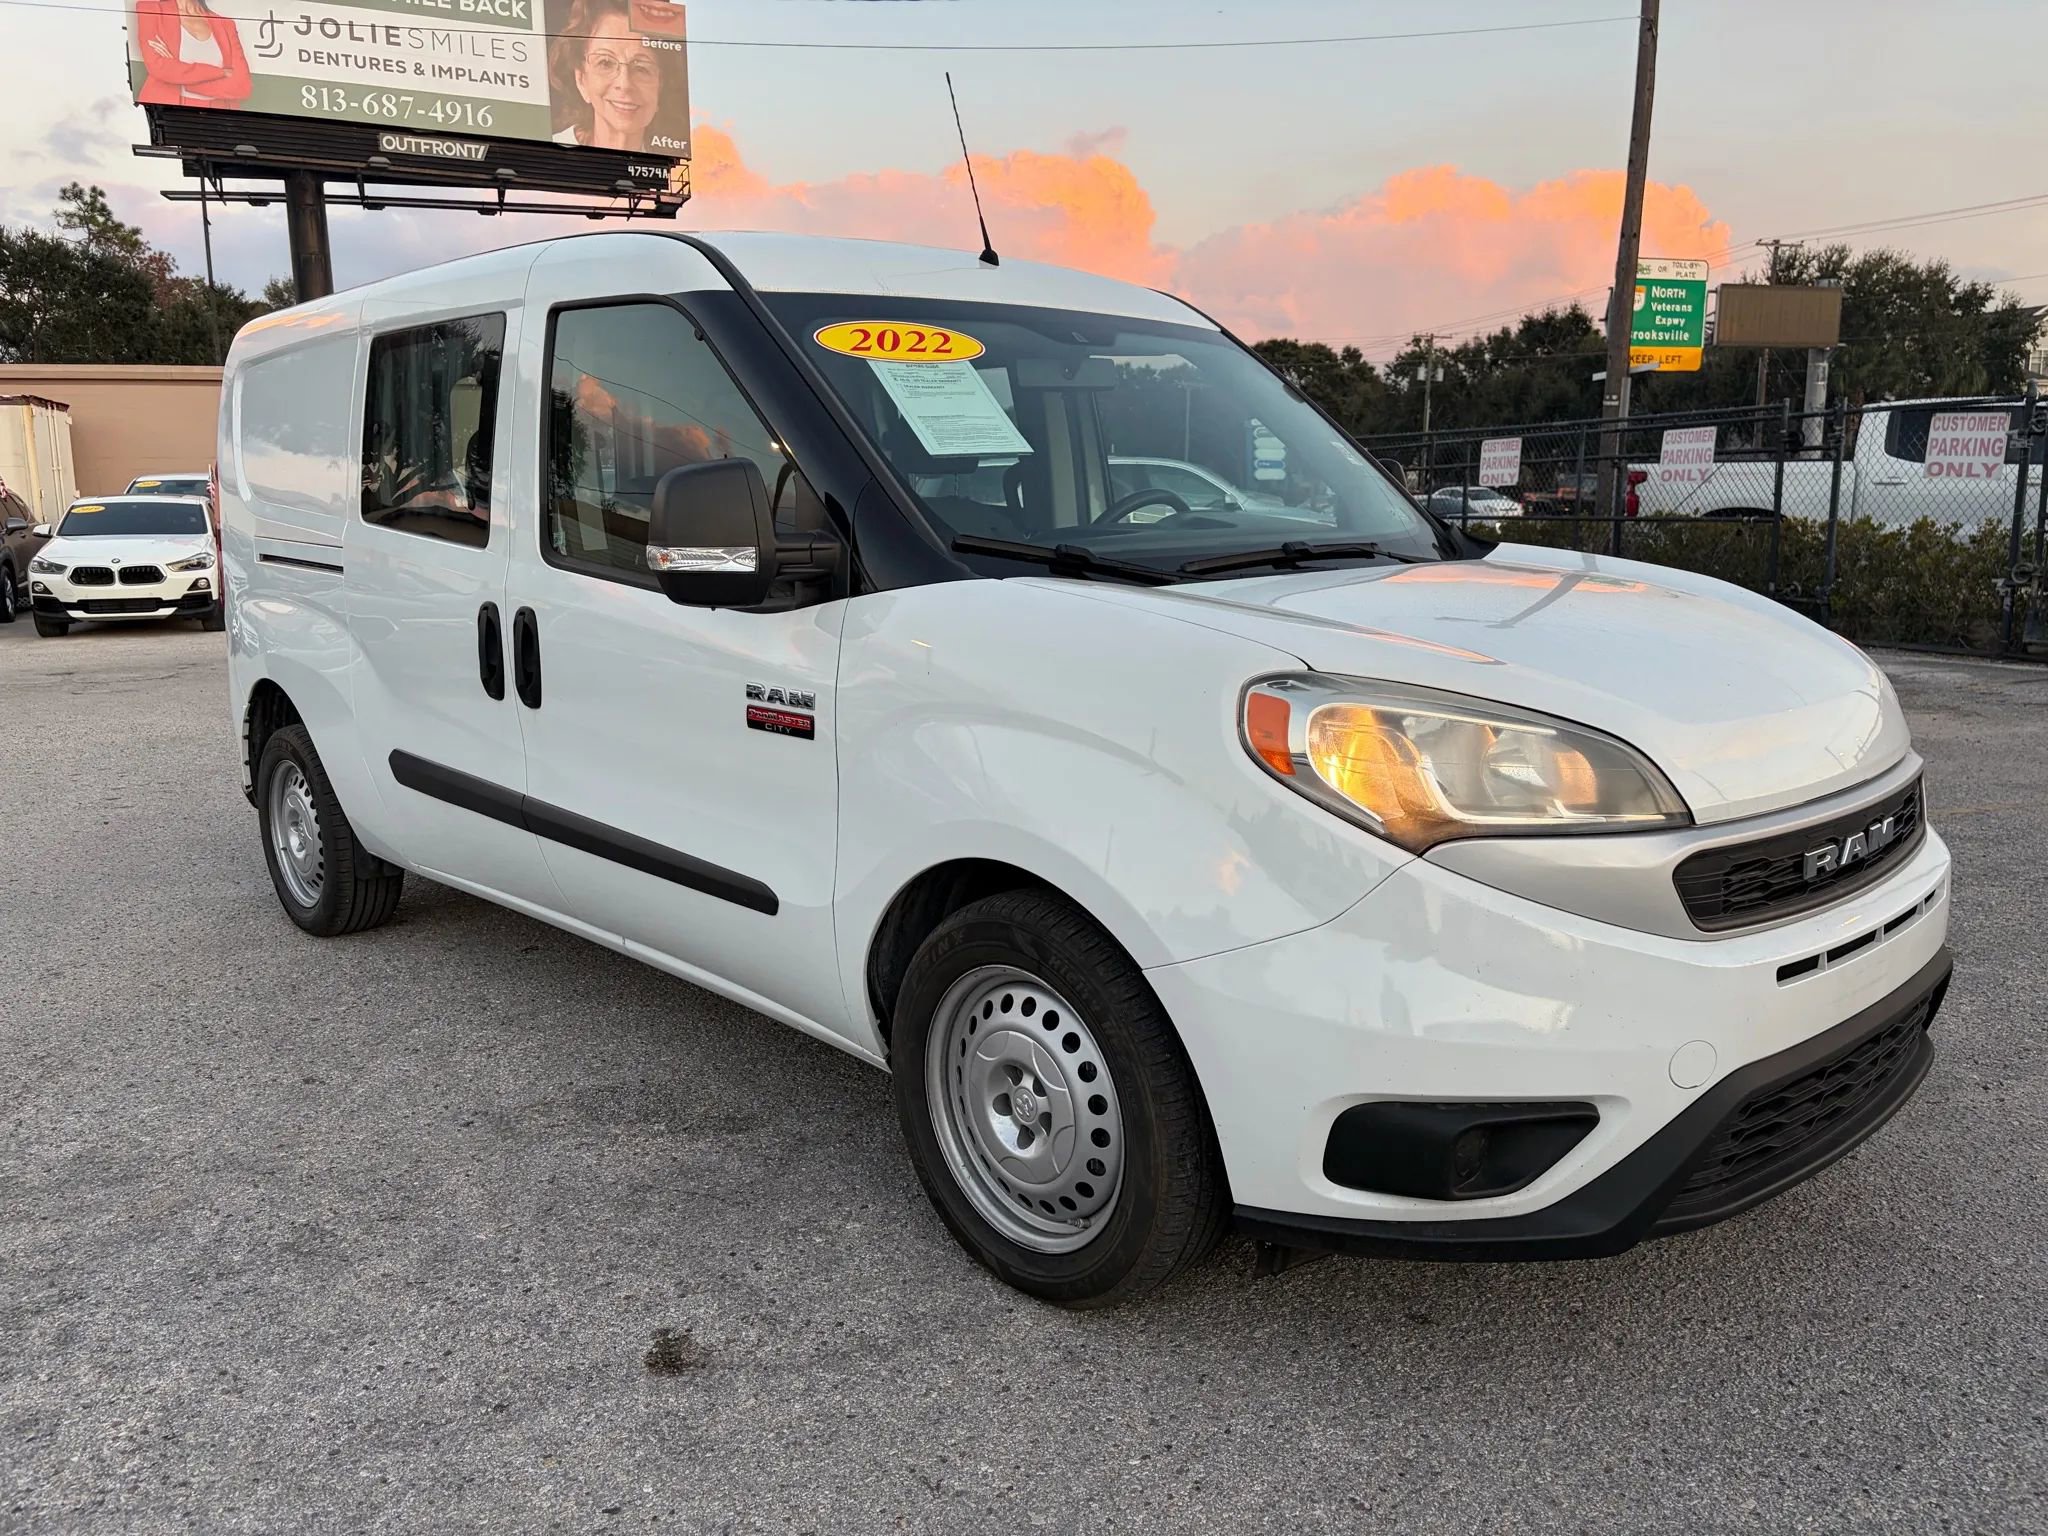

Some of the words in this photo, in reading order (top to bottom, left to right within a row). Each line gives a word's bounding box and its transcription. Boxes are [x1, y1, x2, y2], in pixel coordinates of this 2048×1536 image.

[459, 0, 528, 20] BACK
[642, 37, 682, 51] Before
[298, 48, 408, 74] DENTURES
[413, 62, 426, 76] &
[431, 64, 530, 88] IMPLANTS
[300, 84, 494, 128] 813-687-4916
[651, 136, 687, 149] After
[1675, 271, 1696, 279] PLATE
[1651, 285, 1686, 299] NORTH
[1651, 302, 1693, 313] Veterans
[1655, 315, 1685, 327] Expwy
[849, 328, 953, 354] 2022
[1630, 330, 1690, 341] rooksville
[1659, 354, 1682, 364] LEFT
[1932, 416, 2007, 432] CUSTOMER
[1664, 429, 1714, 443] CUSTOMER
[1482, 439, 1520, 453] CUSTOMER
[1928, 437, 2004, 457] PARKING
[1481, 455, 1519, 470] PARKING
[1661, 449, 1713, 465] PARKING
[1660, 467, 1711, 482] ONLY
[1926, 461, 2000, 478] ONLY
[1480, 473, 1517, 485] ONLY
[746, 682, 815, 710] RAM
[765, 723, 792, 733] CITY
[1804, 816, 1895, 880] RAM
